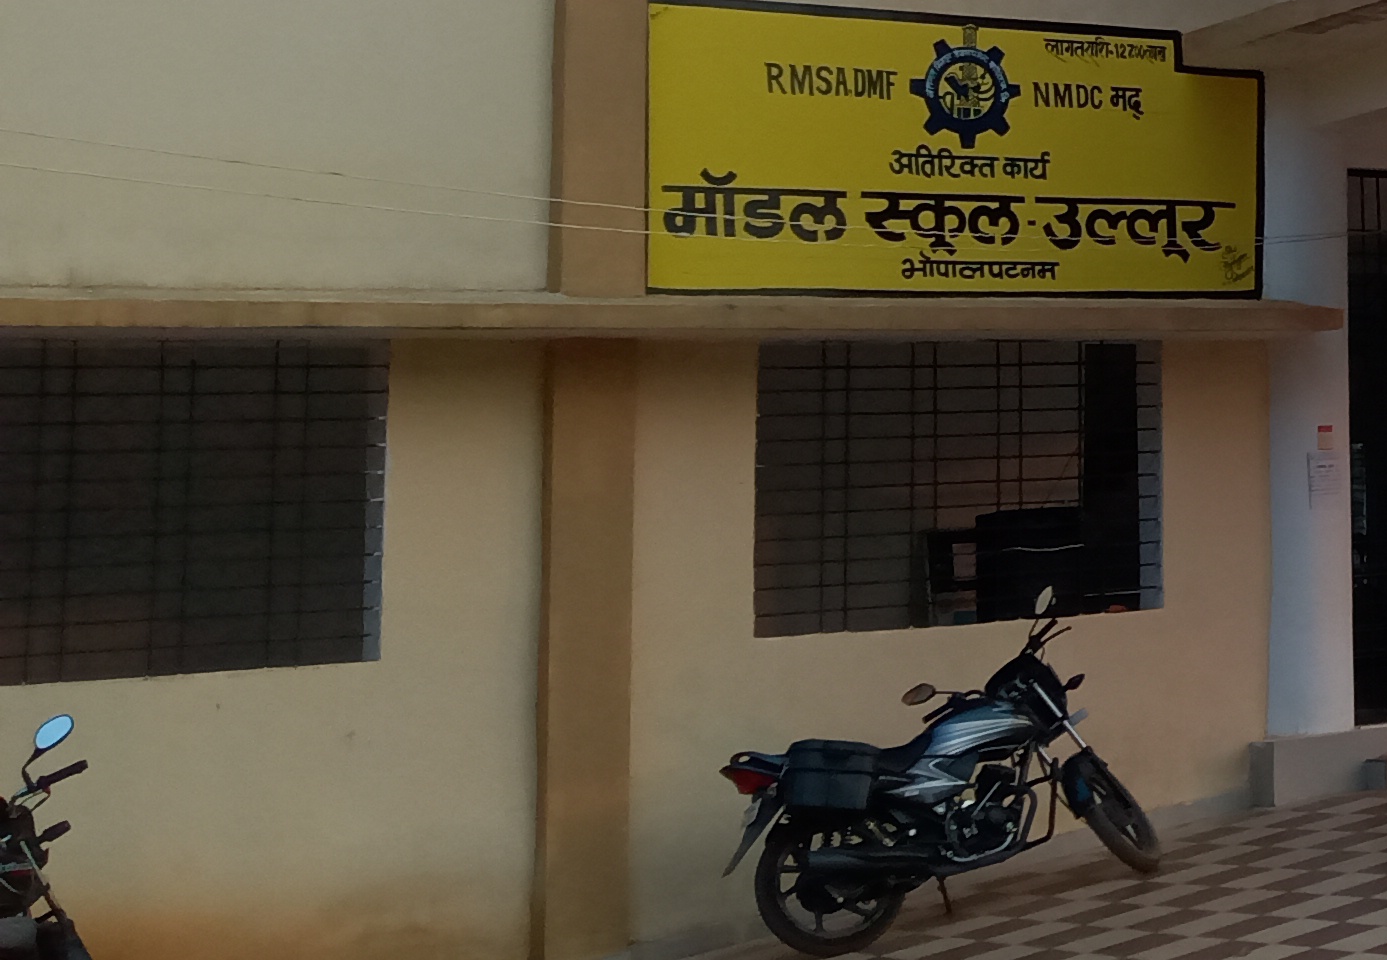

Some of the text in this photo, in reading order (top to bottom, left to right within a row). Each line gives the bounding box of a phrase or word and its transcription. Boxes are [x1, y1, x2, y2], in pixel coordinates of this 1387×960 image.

[1032, 81, 1103, 109] NMDC
[889, 144, 1051, 181] अतिरिक्त कार्य
[661, 168, 847, 242] मॉडल
